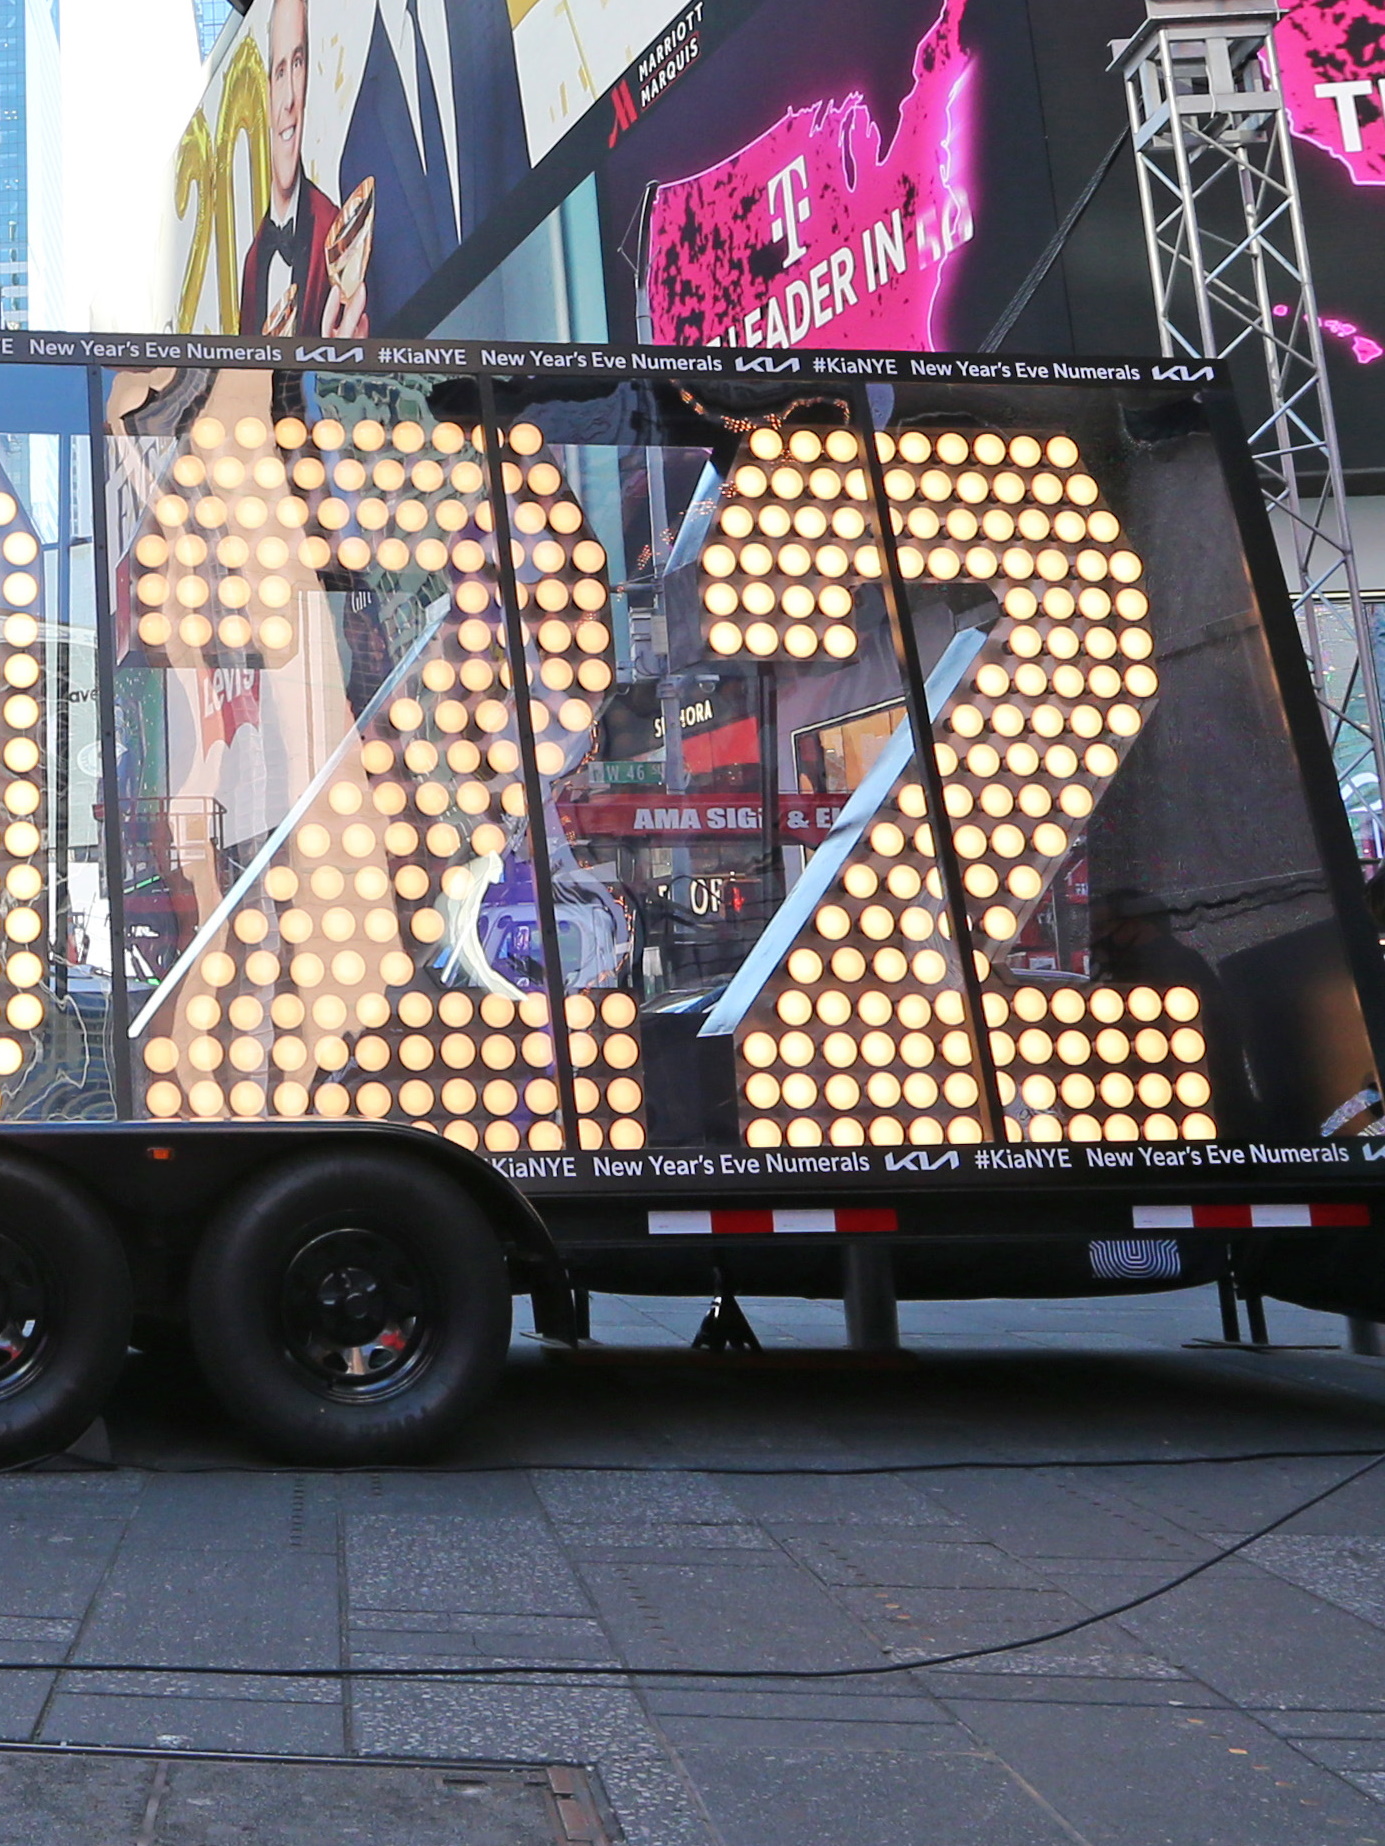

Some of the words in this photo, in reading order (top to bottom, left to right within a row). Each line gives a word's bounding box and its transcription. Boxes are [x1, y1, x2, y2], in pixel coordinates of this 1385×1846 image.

[638, 1, 703, 82] MARRIOTT
[640, 37, 698, 107] MARQUIS
[861, 208, 907, 293] IN
[30, 341, 75, 356] New
[81, 340, 139, 358] Year's
[146, 342, 181, 359] Eve
[187, 343, 282, 361] Numerals
[378, 348, 467, 365] #KiaNYE
[482, 350, 524, 367] New
[530, 351, 587, 368] Year's
[592, 352, 626, 369] Eve
[632, 354, 722, 371] Numerals
[813, 357, 897, 375] #KiaNYE
[911, 360, 951, 375] New
[956, 361, 1011, 377] Year's
[1016, 363, 1048, 378] Eve
[1052, 364, 1140, 380] Numerals
[606, 764, 619, 781] W
[626, 764, 645, 780] 46
[633, 807, 701, 830] AMA
[787, 810, 809, 829] &
[594, 1157, 643, 1177] New
[649, 1155, 715, 1176] Year's
[720, 1154, 760, 1174] Eve
[766, 1152, 870, 1173] Numerals
[975, 1148, 1071, 1170] #KiaNYE
[1087, 1148, 1134, 1168] New
[1139, 1146, 1202, 1166] Year's
[1210, 1144, 1245, 1164] Eve
[1249, 1143, 1349, 1163] Numerals
